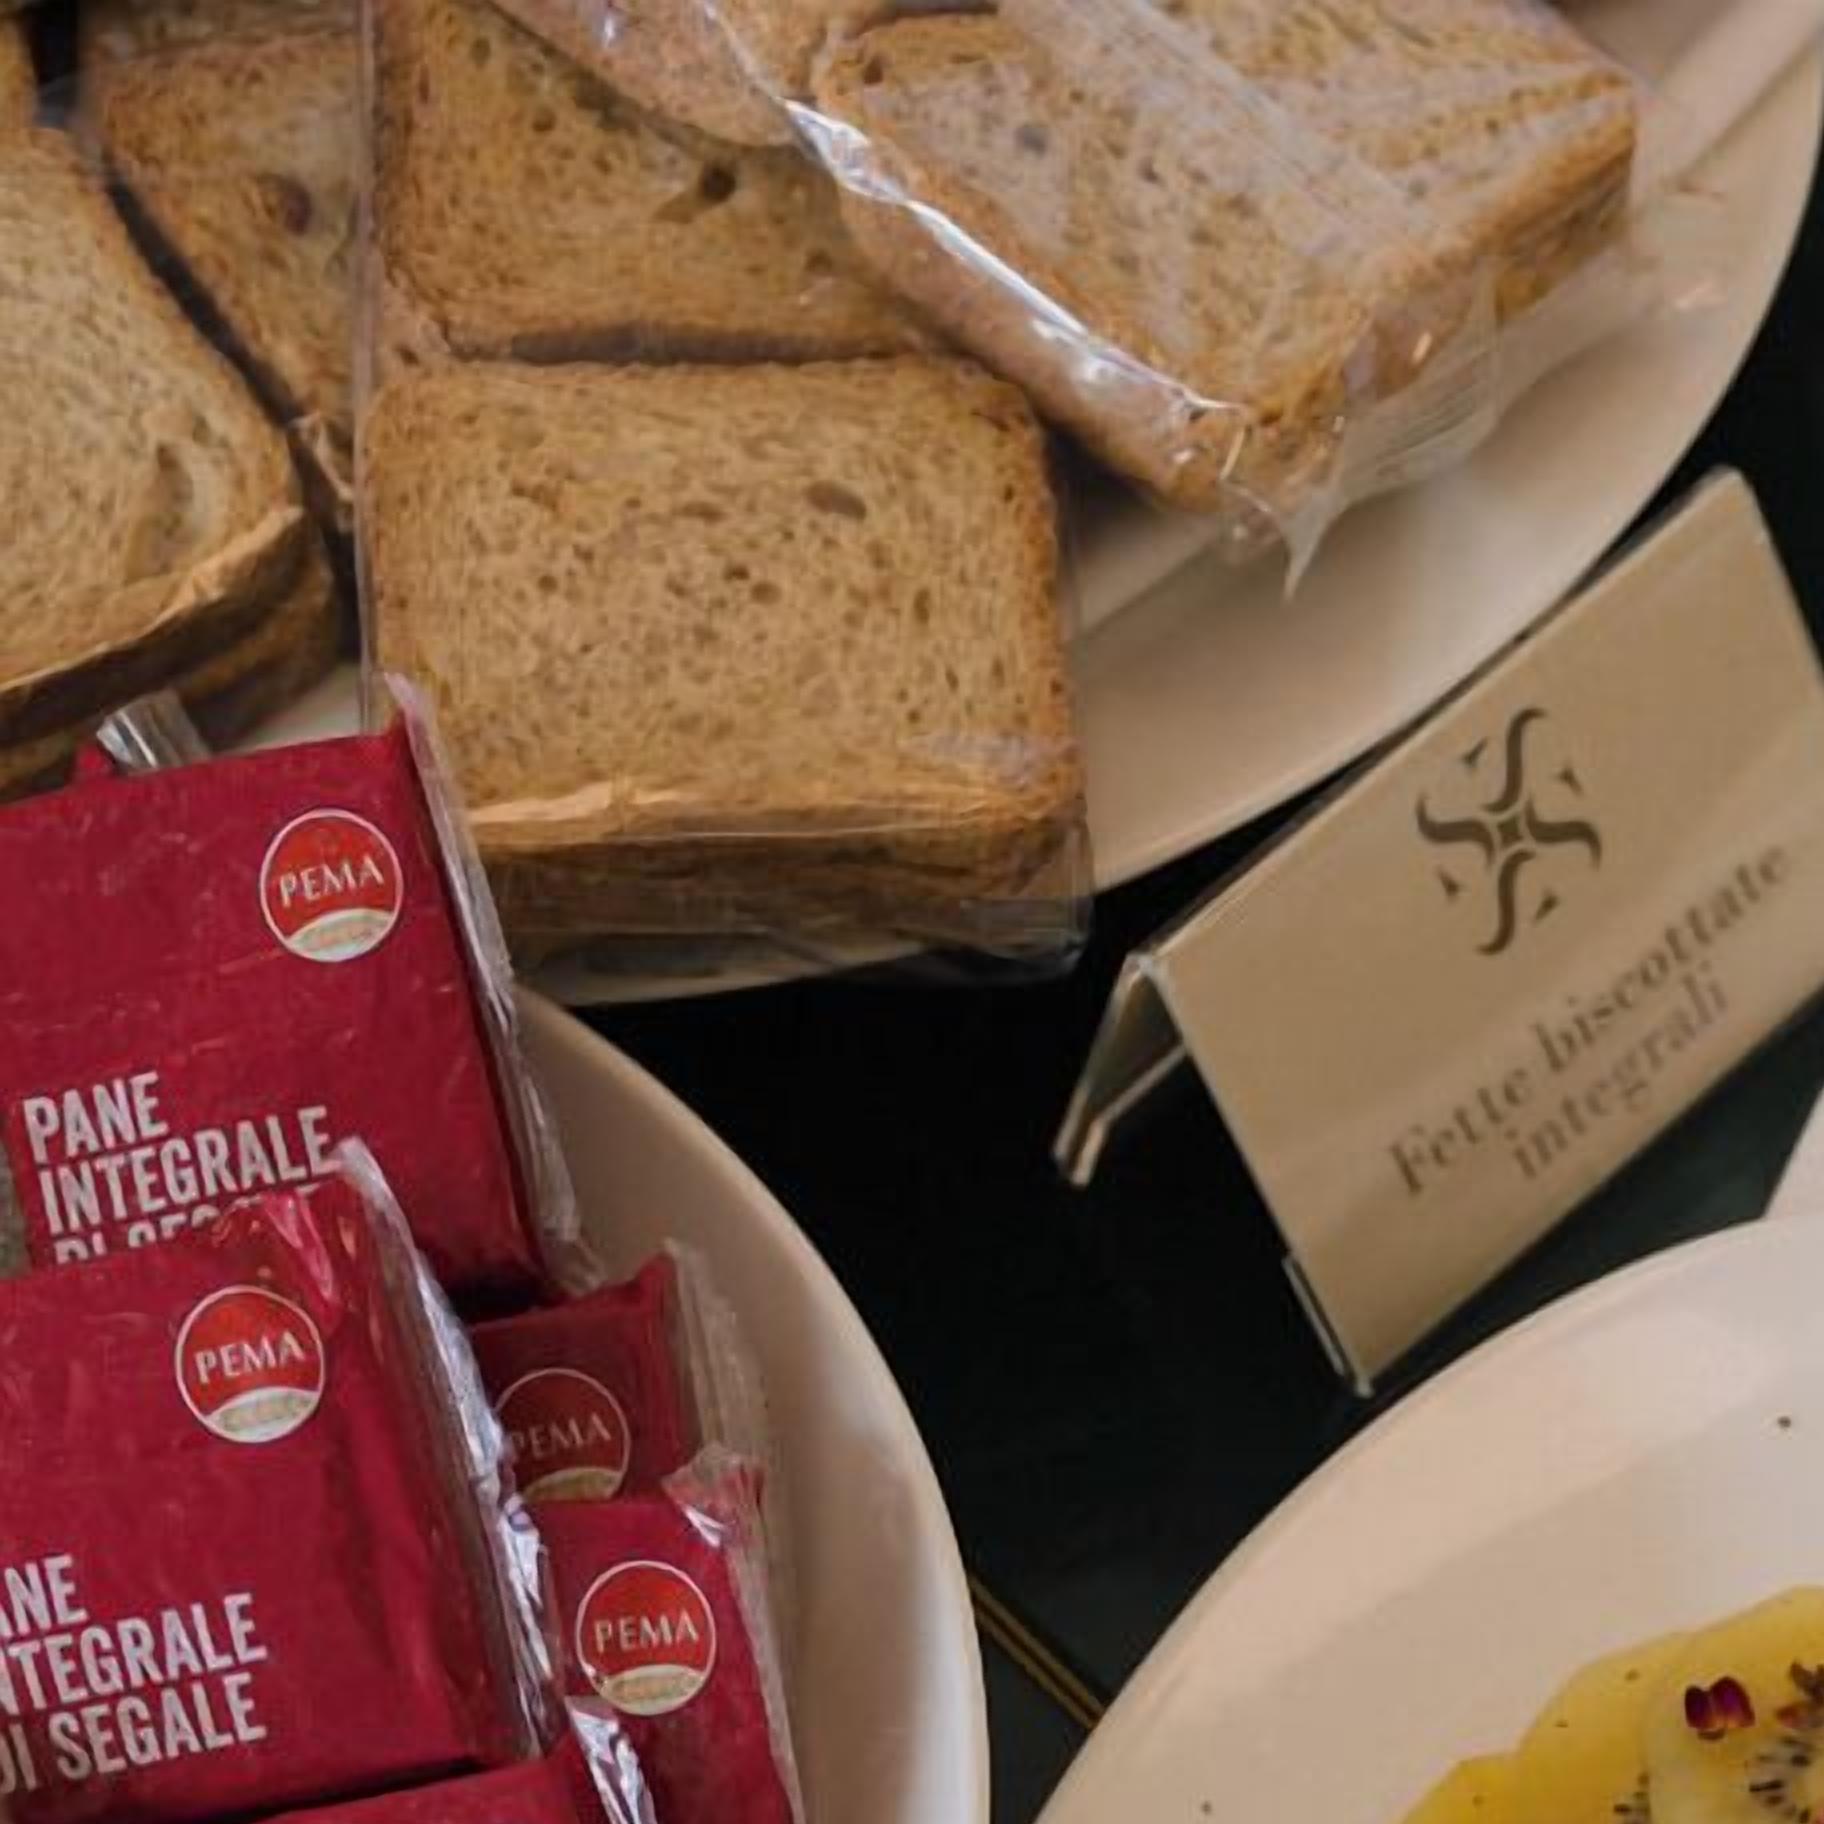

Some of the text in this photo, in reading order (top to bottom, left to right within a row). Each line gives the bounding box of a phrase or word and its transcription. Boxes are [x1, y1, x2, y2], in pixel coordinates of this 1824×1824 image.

[279, 854, 385, 908] PEMA
[1388, 845, 1791, 1196] Fette biscottate
[1504, 960, 1729, 1180] integrali
[23, 1069, 170, 1164] PANE
[37, 1104, 343, 1235] INTEGRALE
[194, 1330, 306, 1384] PEMA
[593, 1608, 699, 1654] PEMA
[48, 1672, 268, 1780] SEGALE
